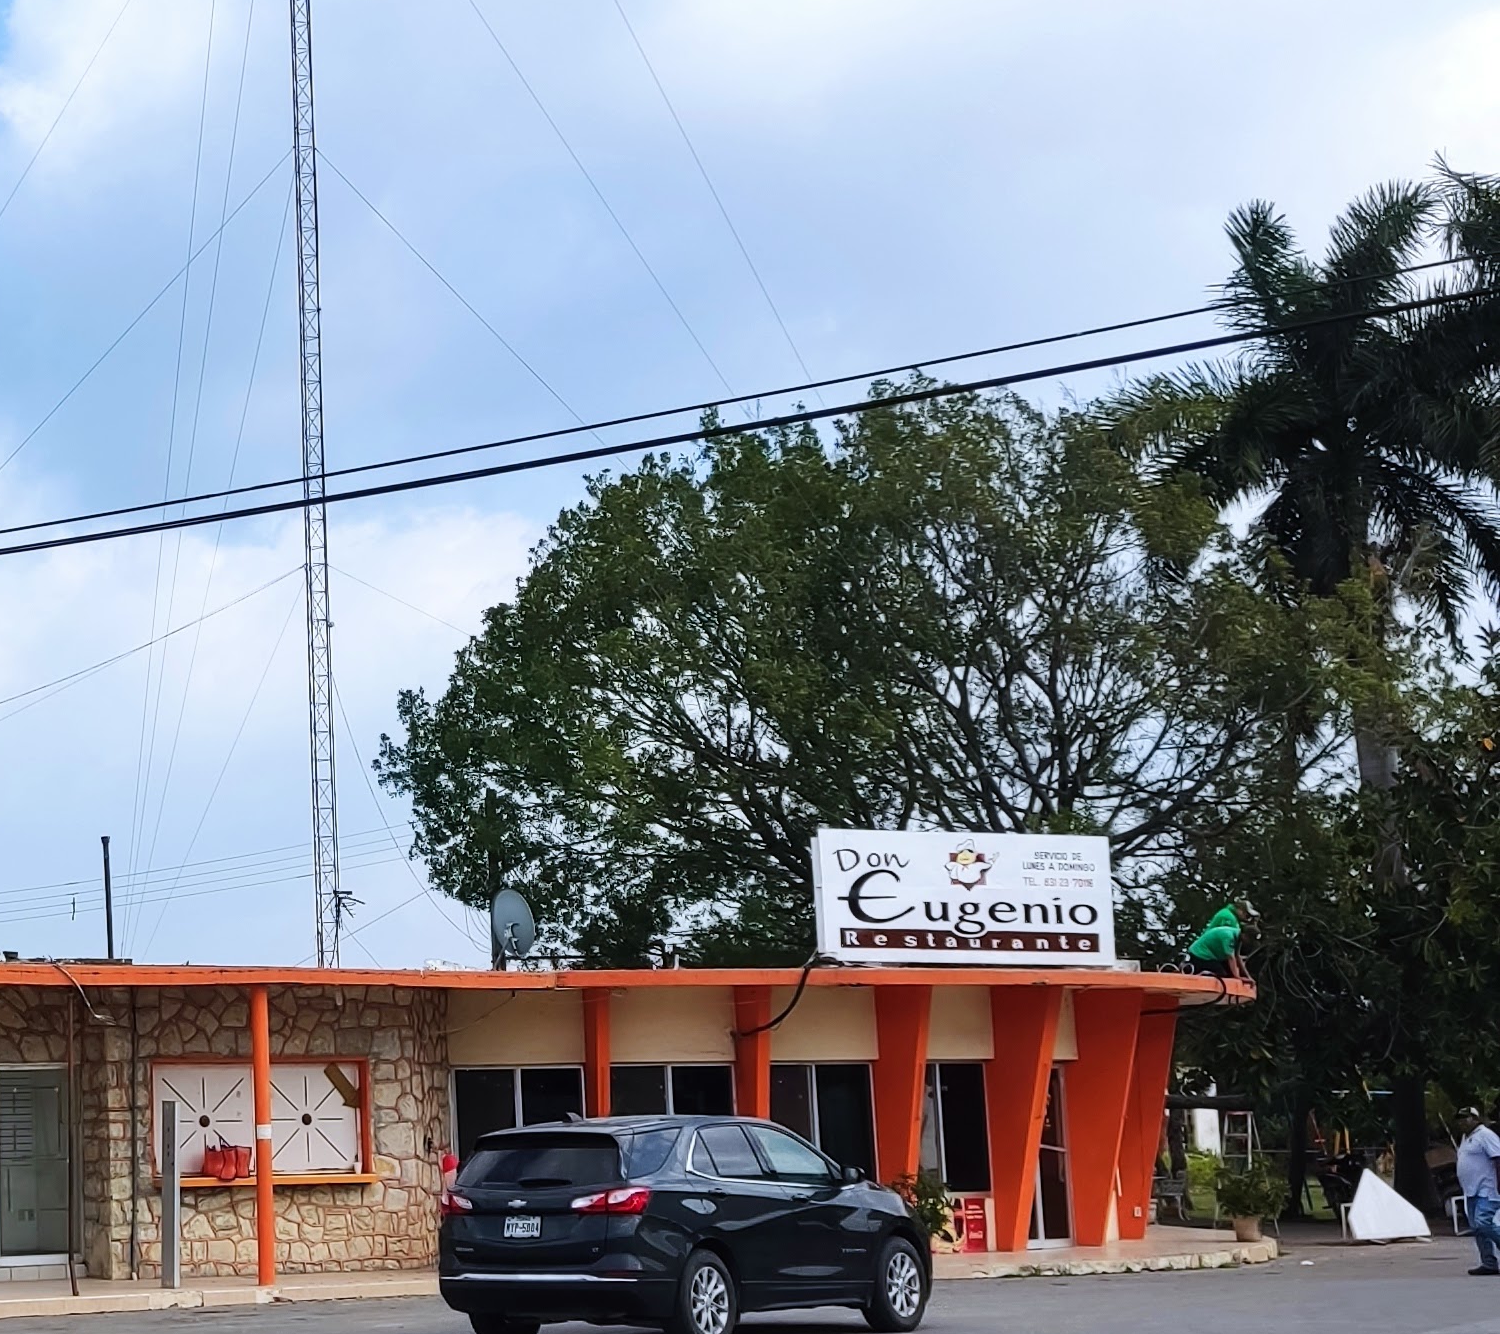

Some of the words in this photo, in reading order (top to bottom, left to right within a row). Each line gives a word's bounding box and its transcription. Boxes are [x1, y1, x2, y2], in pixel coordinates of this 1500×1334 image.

[833, 848, 911, 872] Don
[1022, 861, 1045, 871] LUNES
[1048, 862, 1056, 871] A
[1058, 863, 1096, 872] DOMINGO
[1034, 851, 1067, 861] SERVICIO
[1072, 852, 1083, 861] DE
[838, 869, 1098, 935] Eugenio
[844, 930, 1092, 951] Restaurante
